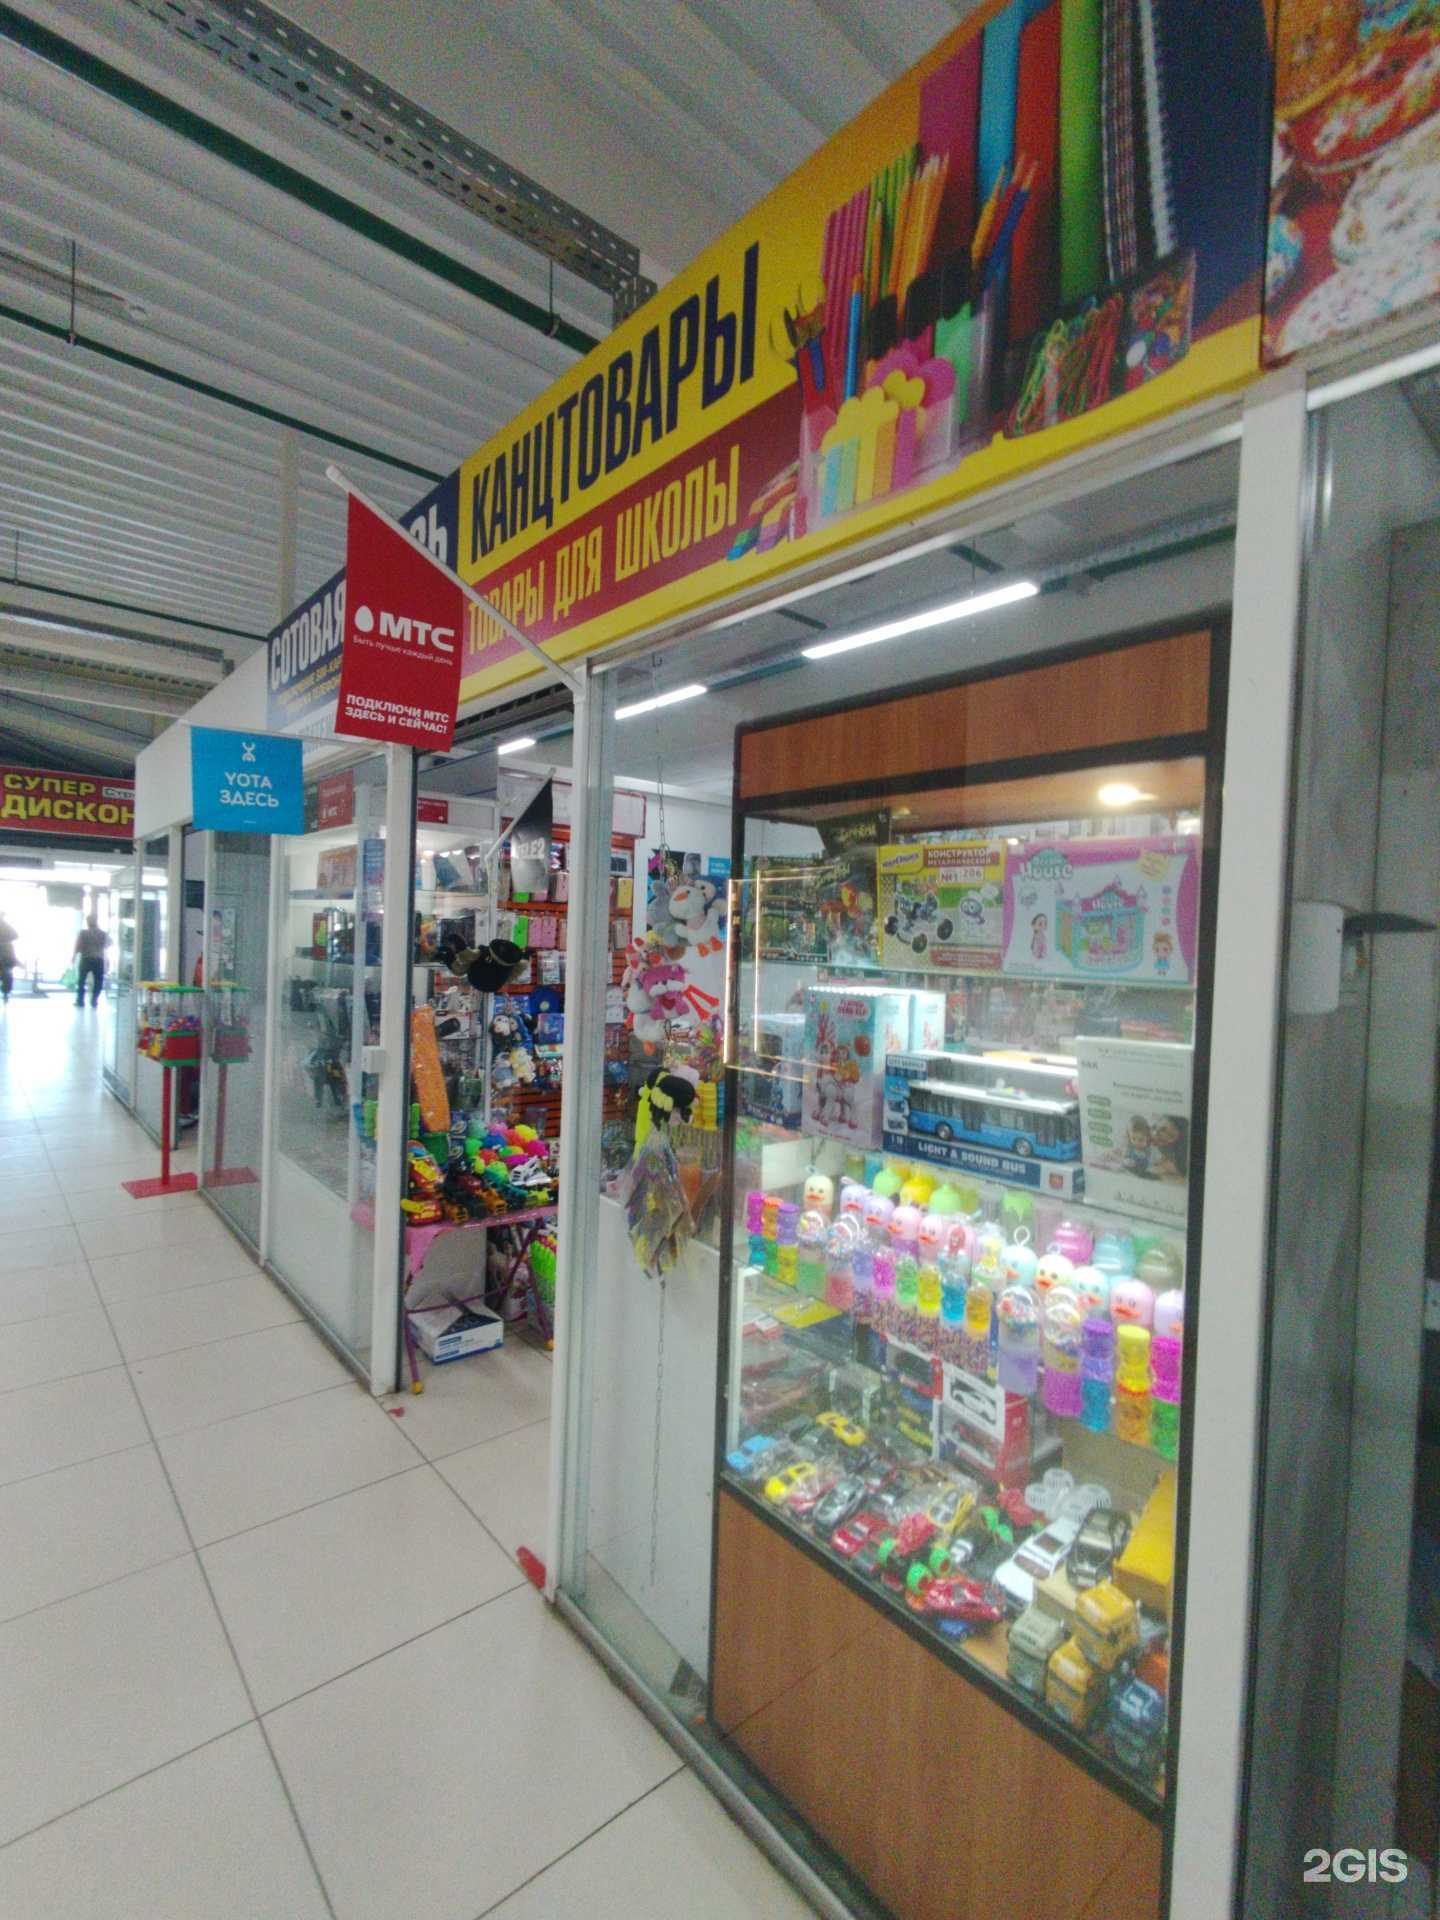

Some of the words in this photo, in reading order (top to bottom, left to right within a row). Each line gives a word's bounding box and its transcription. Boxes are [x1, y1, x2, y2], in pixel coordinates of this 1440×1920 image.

[471, 241, 760, 565] КАНЦТОВАРЫ
[469, 560, 545, 655] ТОВАРЫ
[553, 525, 602, 623] ДЛЯ
[615, 444, 740, 583] ШКОЛЫ
[271, 579, 347, 691] СОТОВАЯ
[379, 611, 455, 653] МТС
[345, 706, 386, 722] ЗДЕСЬ
[387, 715, 396, 724] И
[398, 716, 448, 734] СЕЙЧАС!
[346, 693, 421, 717] ПОДКЛЮЧИ
[423, 709, 449, 723] МТС
[3, 773, 97, 796] СУПЕР
[225, 771, 272, 789] YOTA
[219, 789, 280, 808] ЗДЕСЬ
[918, 1141, 948, 1157] LIGHT
[961, 1148, 999, 1168] SOUND
[1002, 1159, 1026, 1176] BUS
